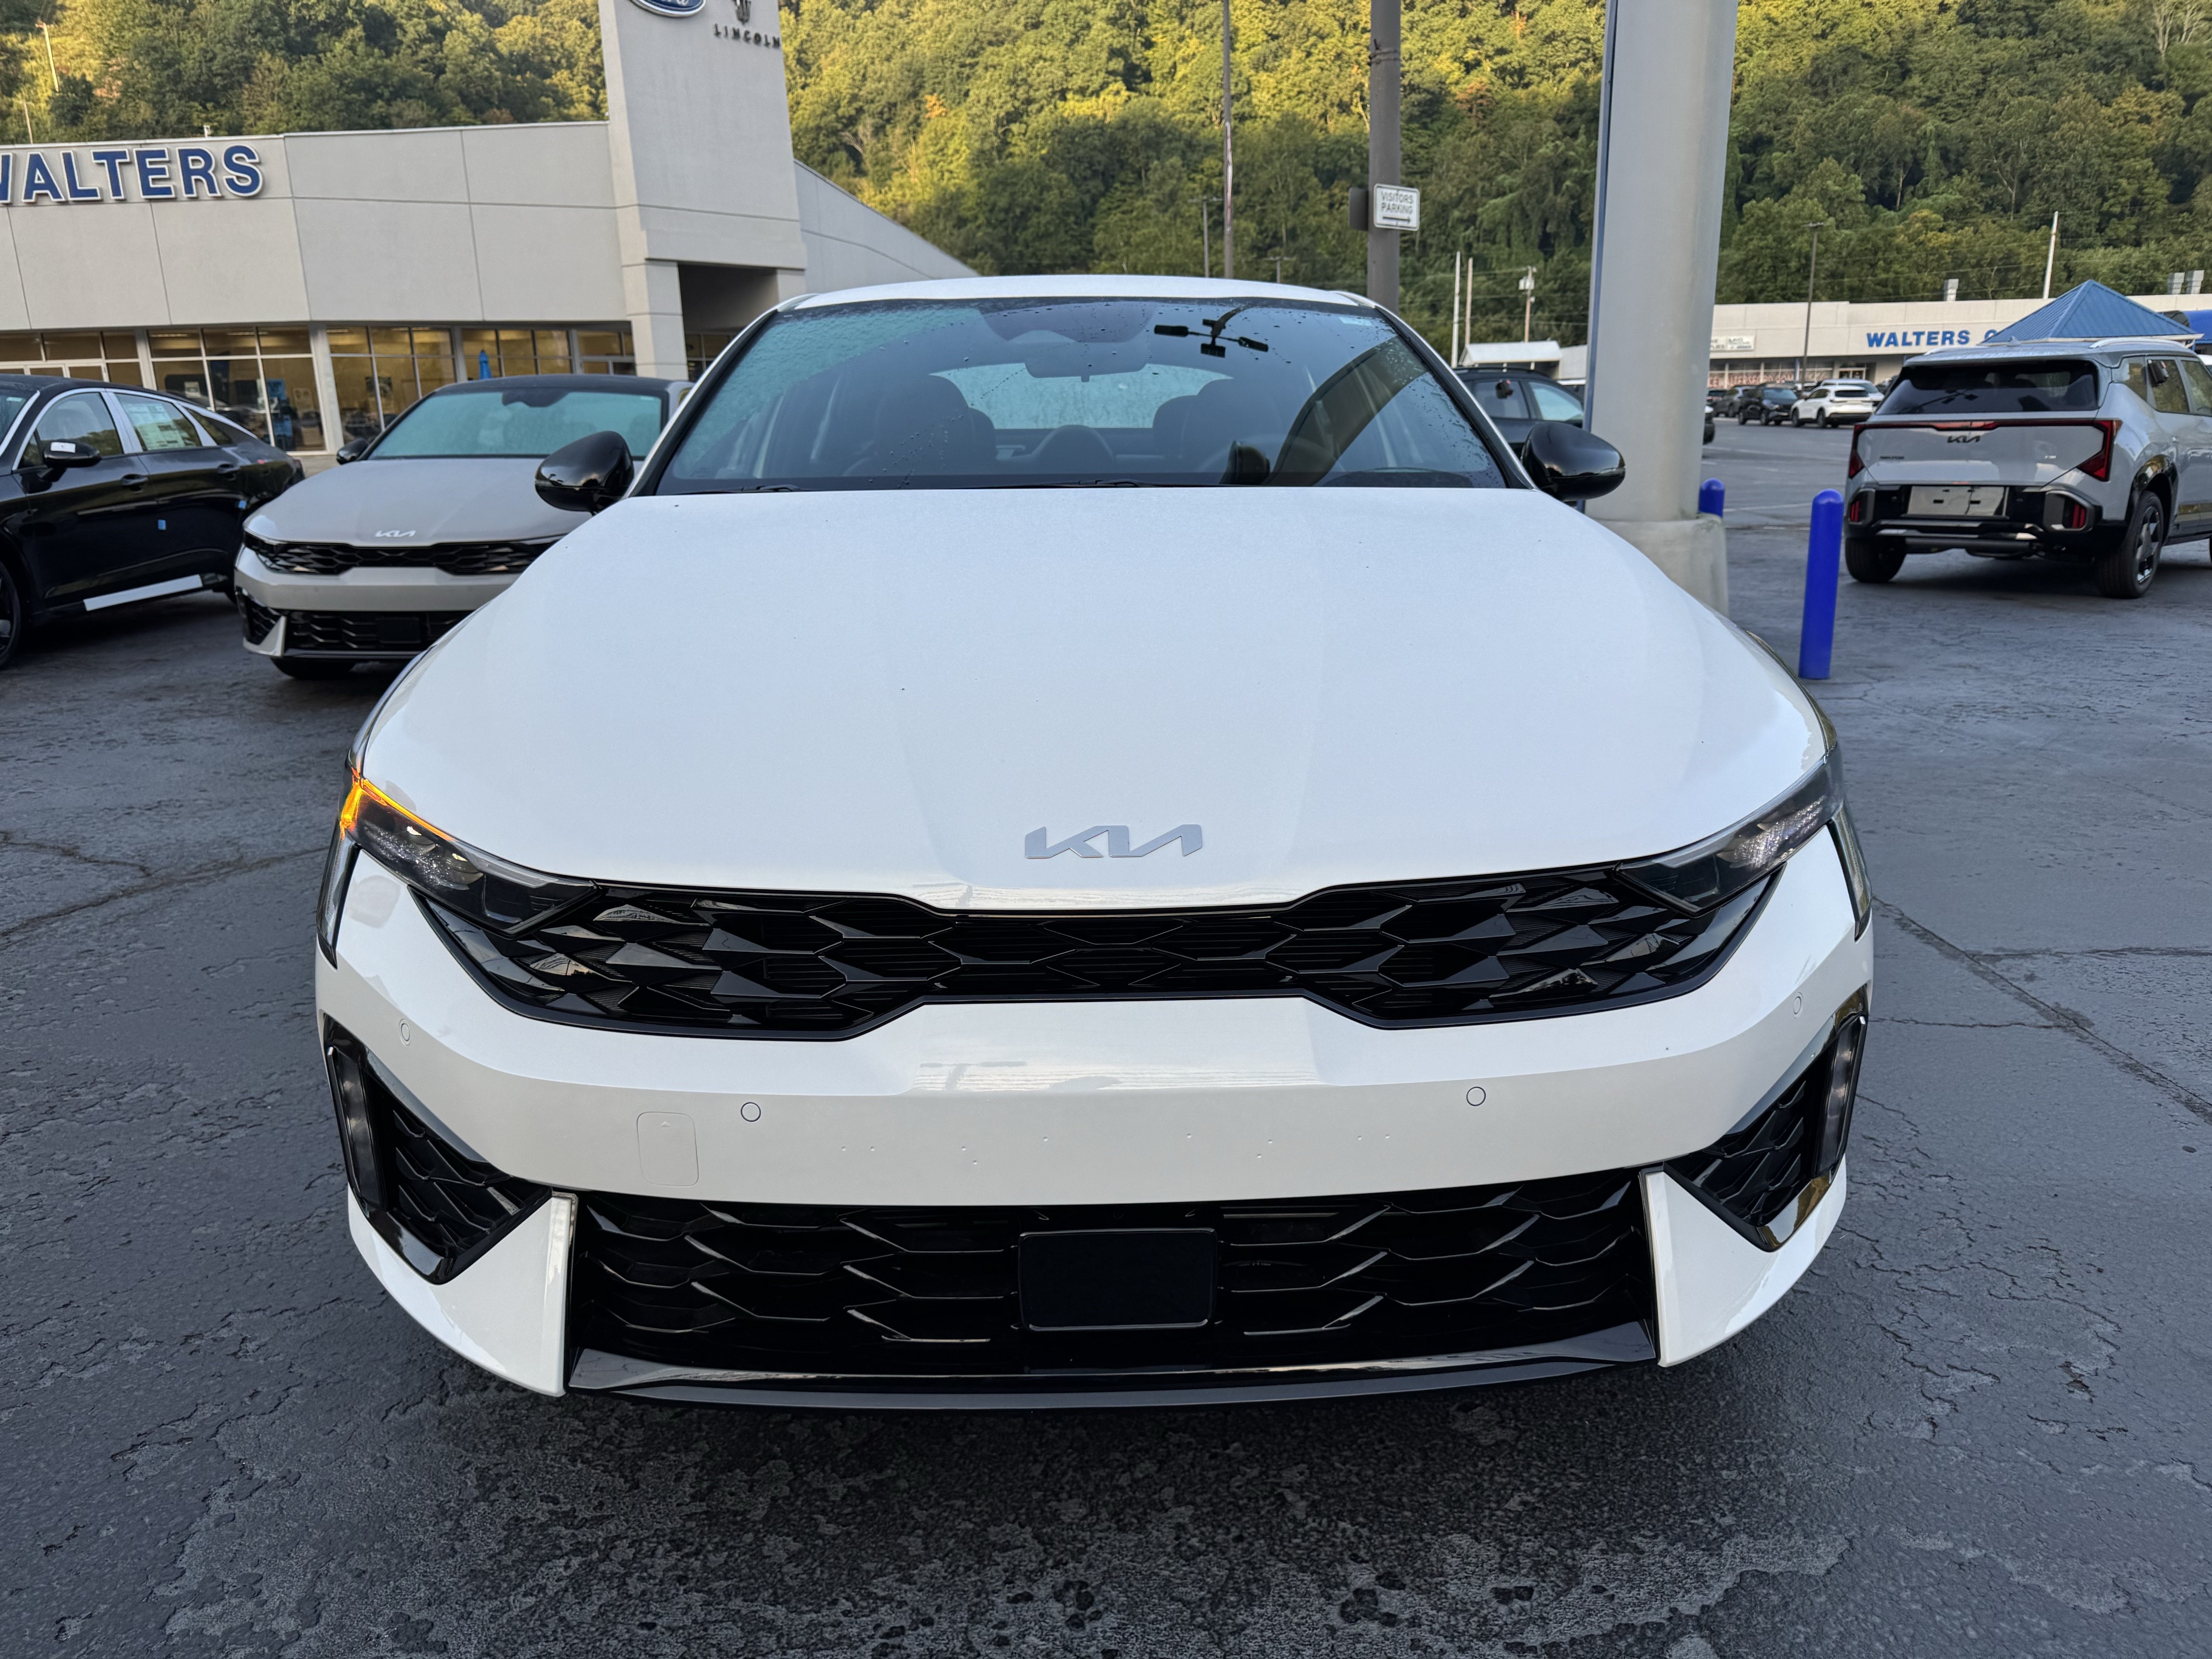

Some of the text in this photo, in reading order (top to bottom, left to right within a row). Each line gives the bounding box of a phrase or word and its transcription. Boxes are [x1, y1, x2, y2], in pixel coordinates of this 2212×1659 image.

[714, 23, 780, 48] LINCOLN
[0, 144, 263, 204] ALTERS
[1381, 191, 1413, 204] VISITORS
[1381, 203, 1413, 215] PARKING
[1867, 329, 1970, 348] WALTERS
[1947, 435, 1981, 443] KIA
[374, 529, 416, 538] KIA
[1024, 824, 1202, 859] KIA
